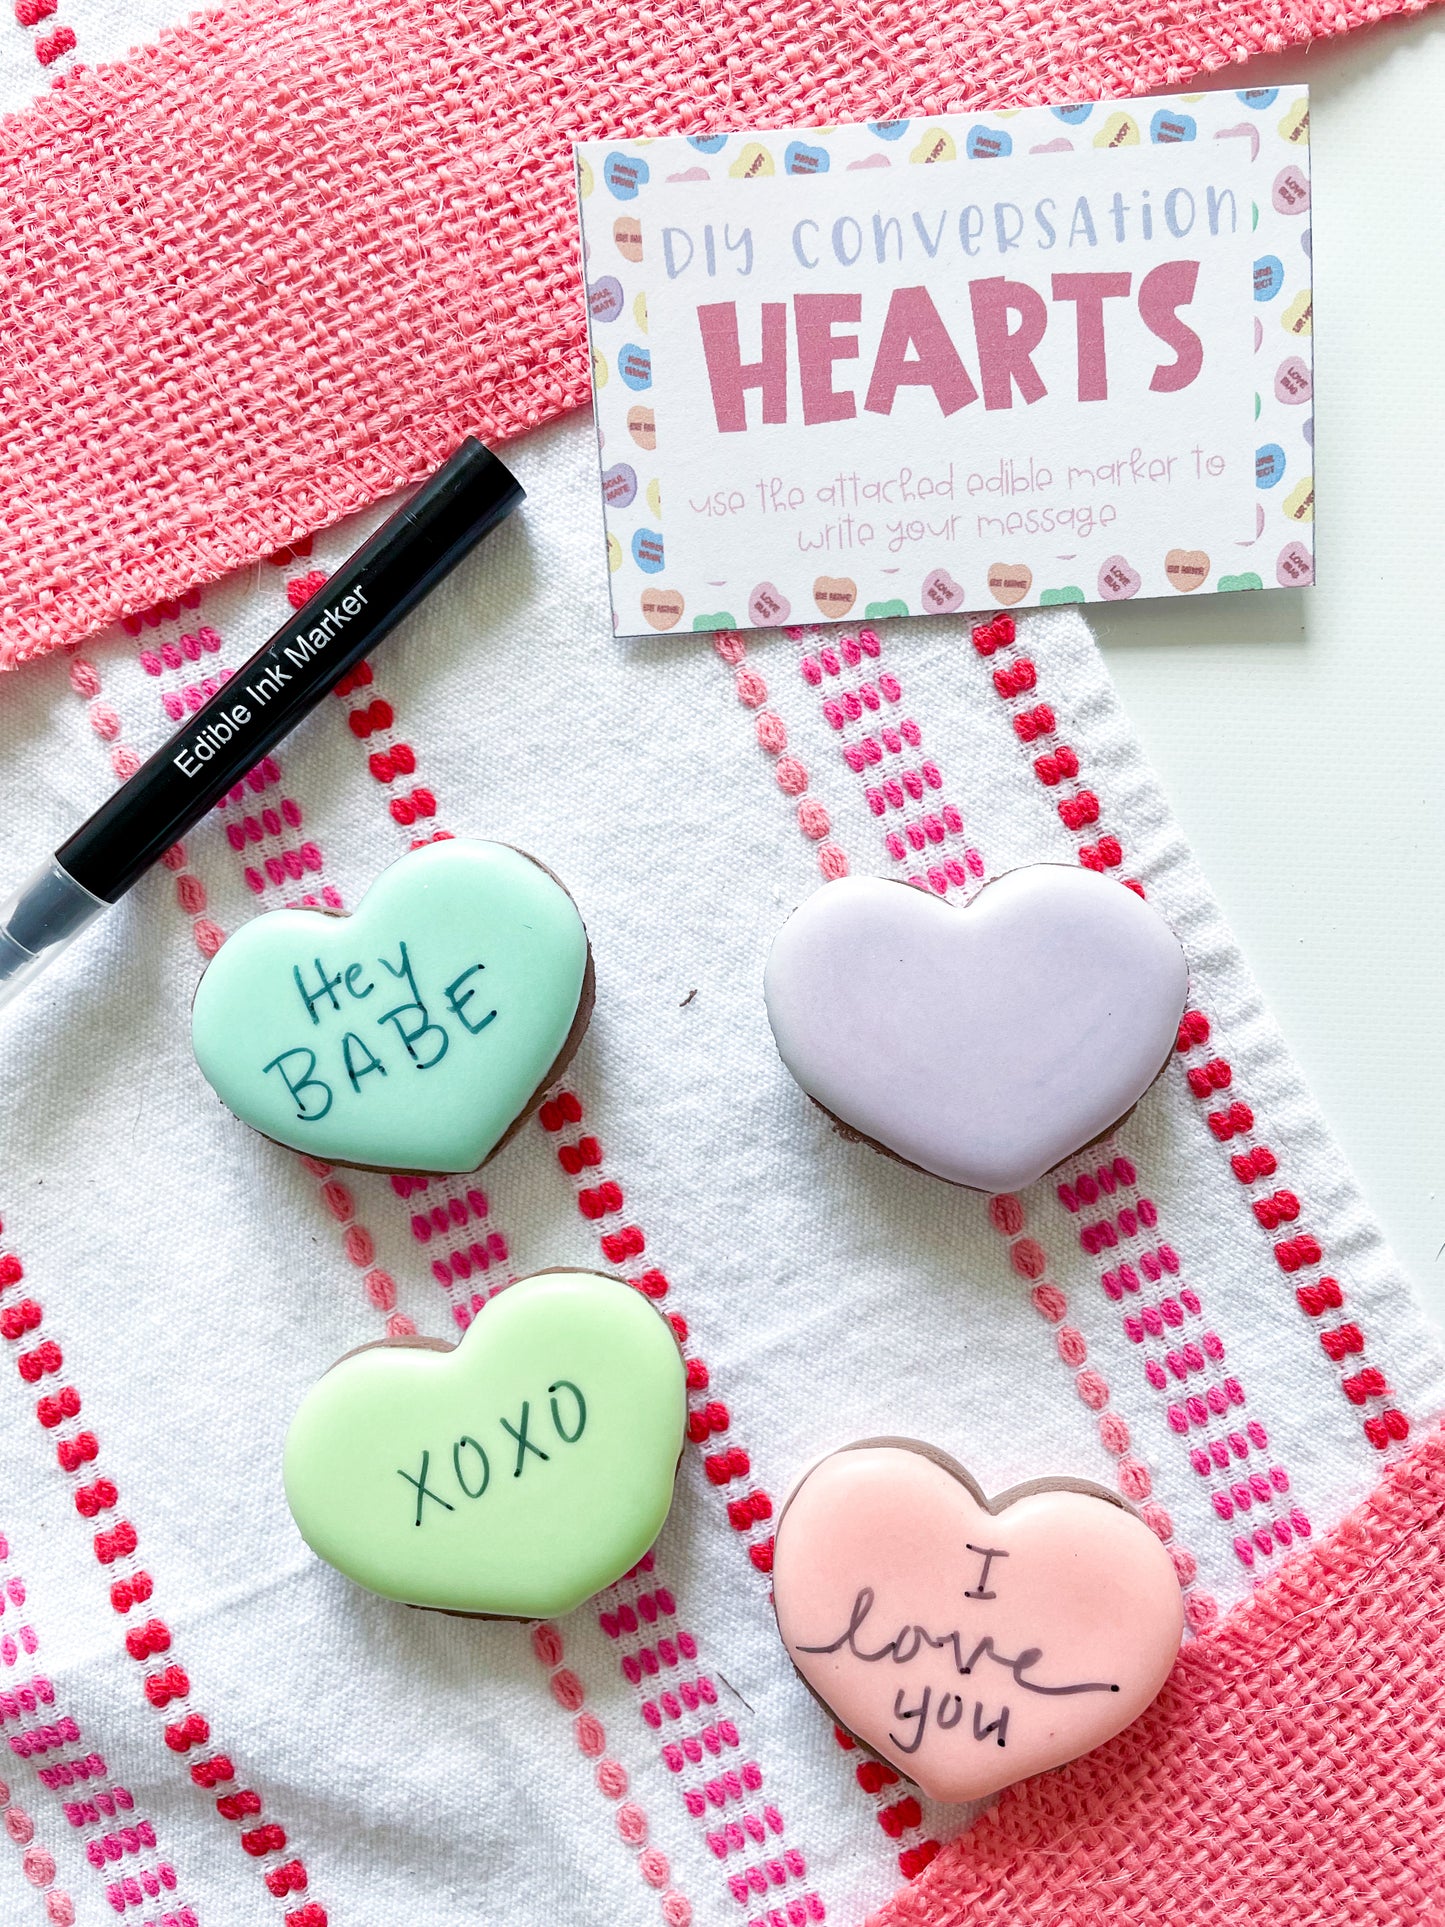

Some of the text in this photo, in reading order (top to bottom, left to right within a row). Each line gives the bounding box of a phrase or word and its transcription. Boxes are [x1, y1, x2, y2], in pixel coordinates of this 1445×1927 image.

[1284, 176, 1307, 199] LOVE
[696, 260, 1203, 433] HEARTS
[1287, 367, 1309, 389] LOVE
[689, 444, 1226, 517] use the attached edible marker to
[798, 504, 1117, 553] write your message
[933, 578, 954, 600] LOVE
[1110, 565, 1131, 587] LOVE
[1288, 551, 1310, 573] LOVE
[760, 591, 781, 613] LOVE
[173, 584, 369, 778] Edible Ink Marker
[293, 941, 426, 1024] Hey
[262, 964, 497, 1121] BABE
[397, 1380, 587, 1526] XOXO
[965, 1543, 1010, 1600] I
[796, 1586, 1121, 1696] love
[889, 1685, 1010, 1754] you
